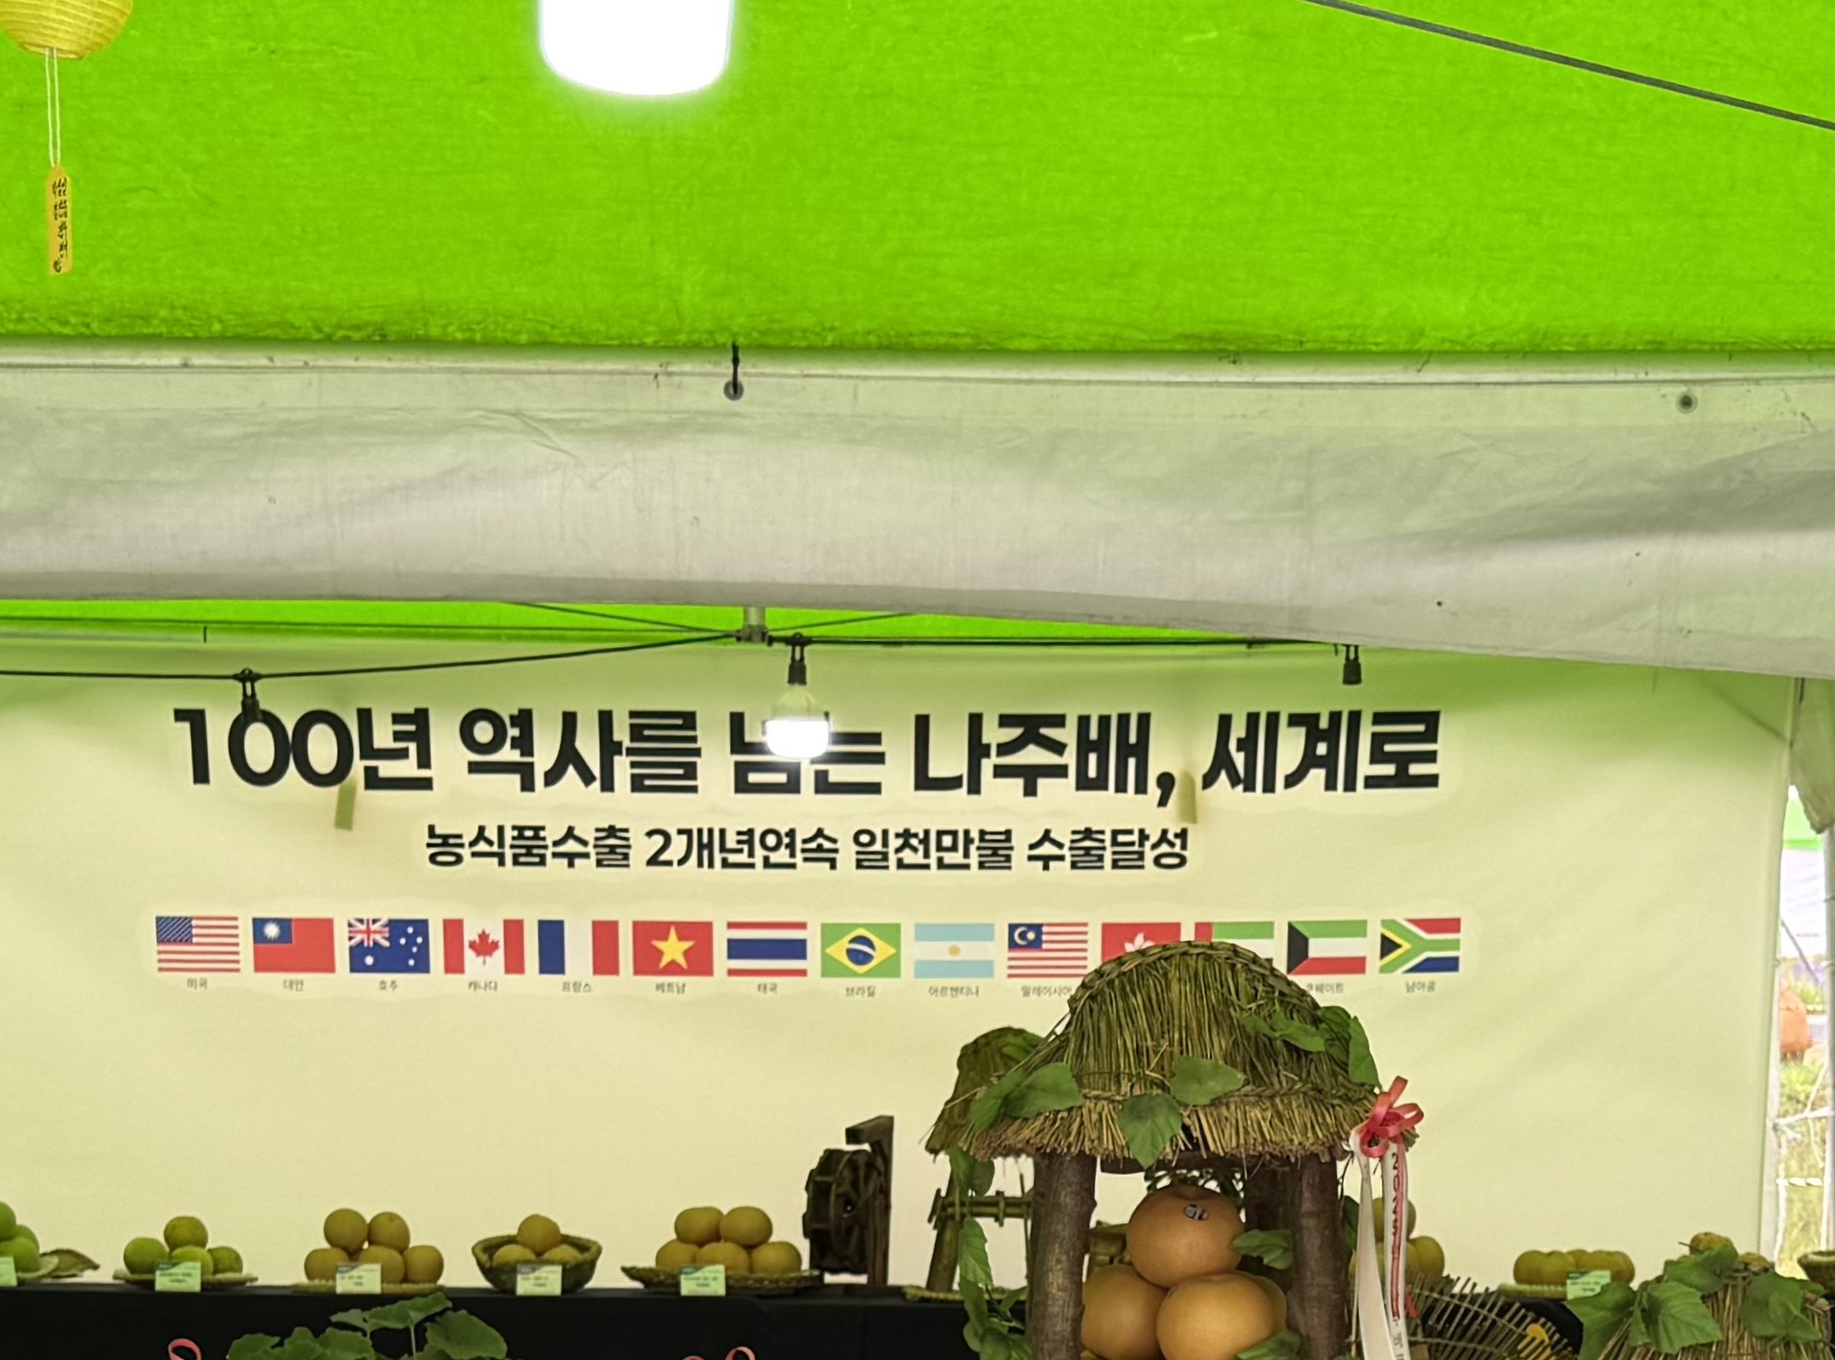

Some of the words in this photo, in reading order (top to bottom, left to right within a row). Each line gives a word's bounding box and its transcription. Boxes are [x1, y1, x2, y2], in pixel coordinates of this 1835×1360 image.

[174, 705, 433, 790] 100년
[459, 708, 701, 793] 역사를
[914, 712, 1176, 808] 나주배,
[1201, 710, 1440, 793] 세계로
[425, 824, 631, 868] 농식품수출
[645, 827, 839, 870] 2개년연속
[852, 827, 1014, 870] 일천만불
[1026, 827, 1188, 871] 수출달성
